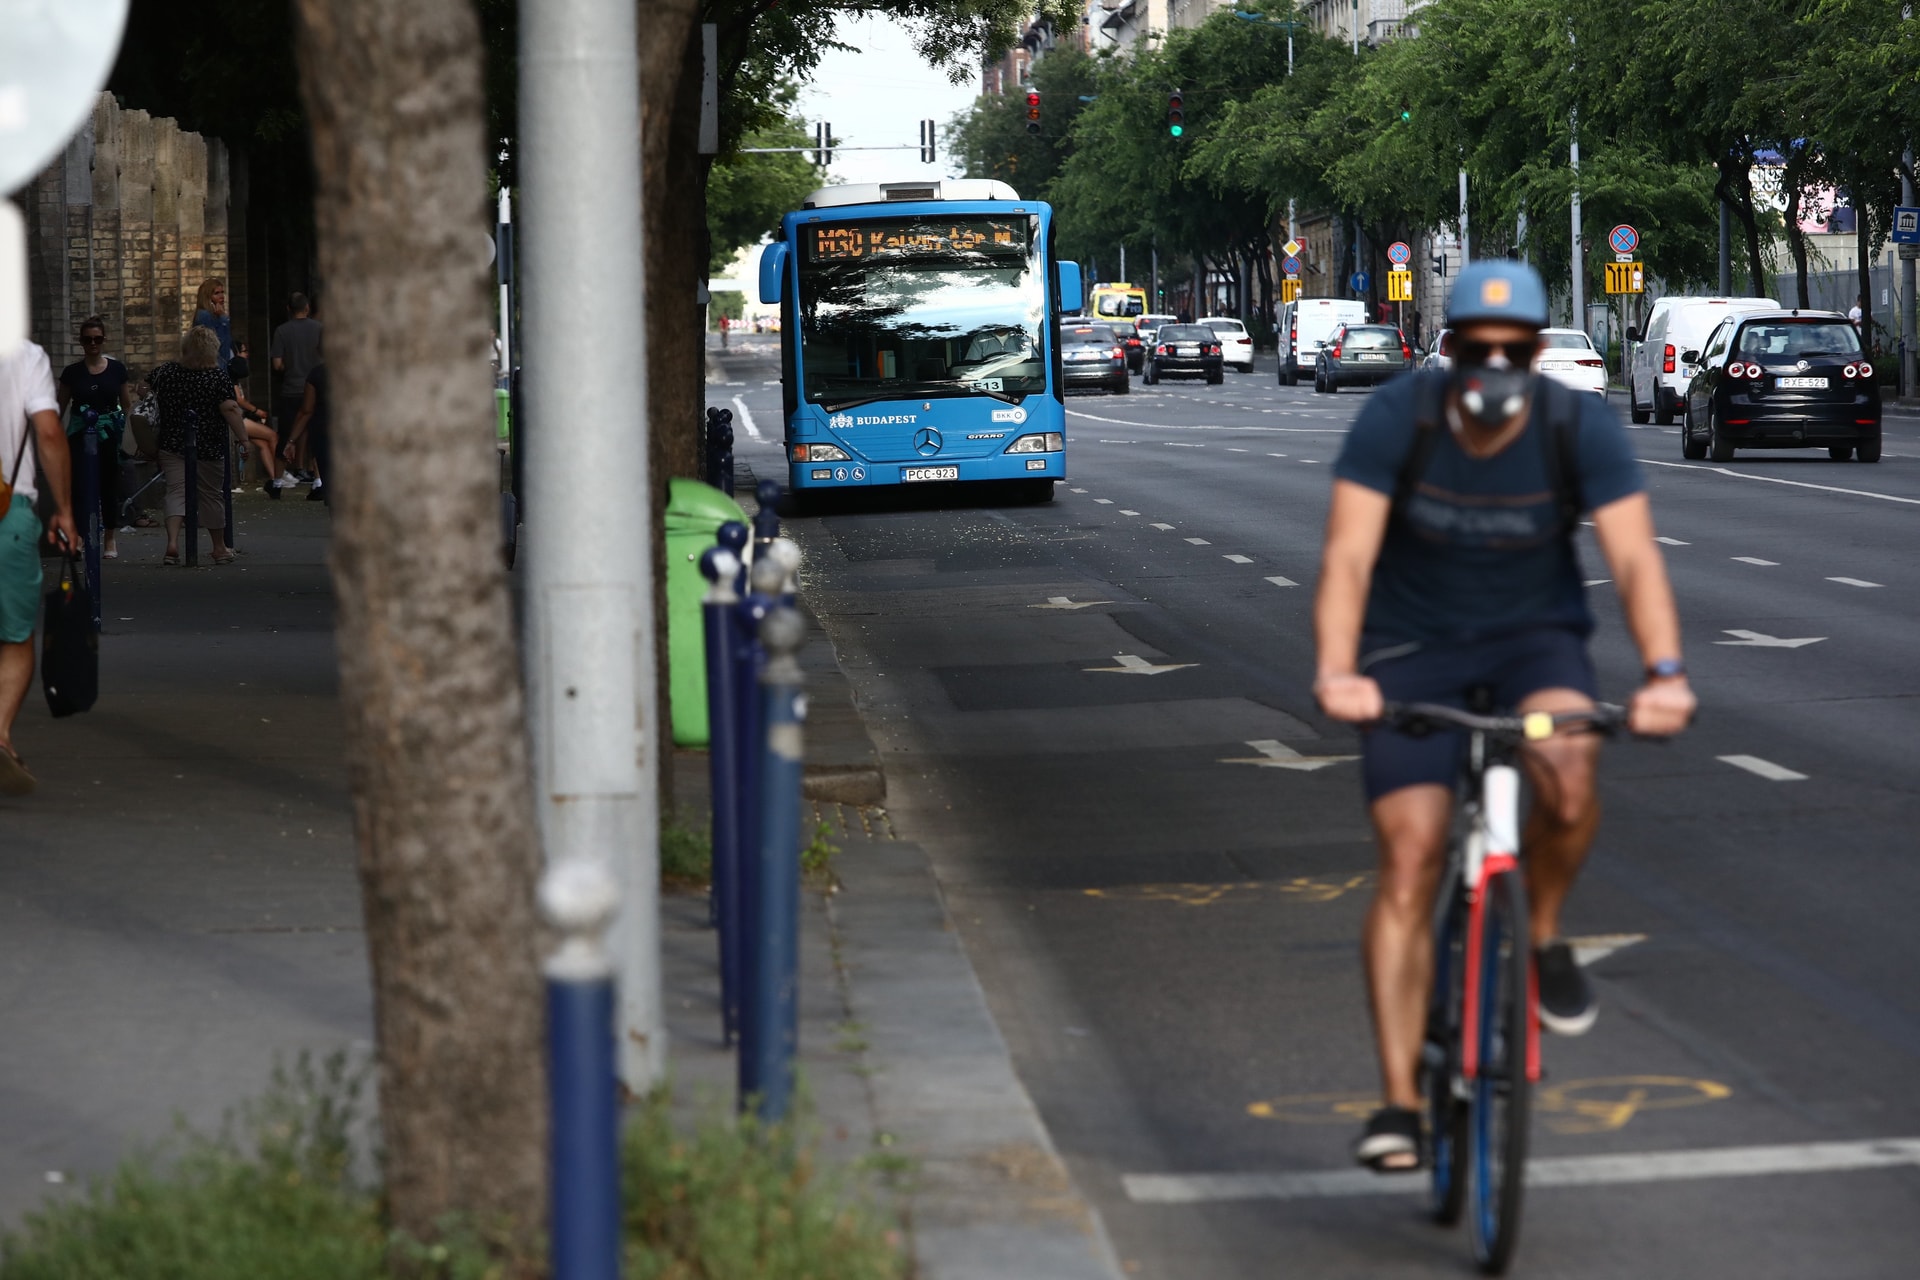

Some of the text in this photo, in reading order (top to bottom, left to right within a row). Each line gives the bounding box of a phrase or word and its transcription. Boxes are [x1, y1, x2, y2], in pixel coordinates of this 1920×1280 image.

[1784, 378, 1826, 387] RXE-529
[857, 415, 917, 425] BUDAPEST
[908, 469, 955, 480] PCC-923
